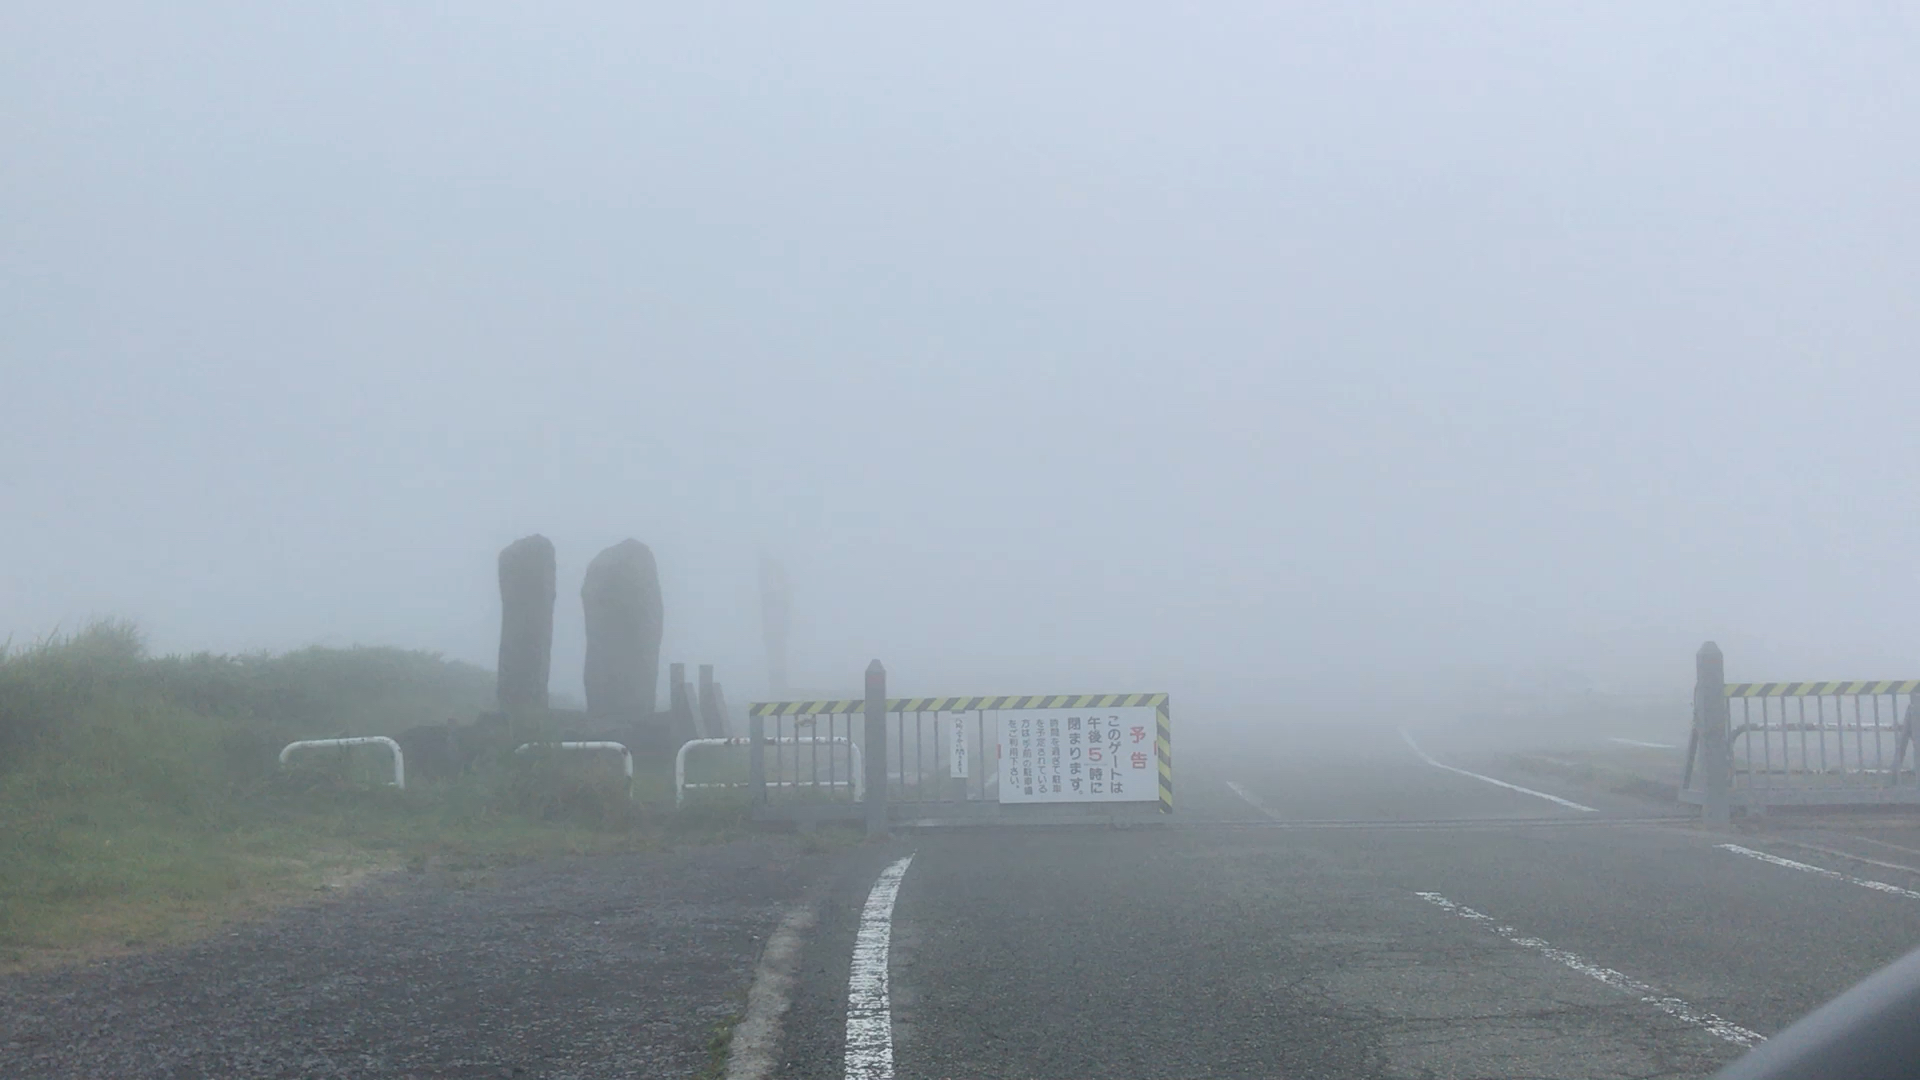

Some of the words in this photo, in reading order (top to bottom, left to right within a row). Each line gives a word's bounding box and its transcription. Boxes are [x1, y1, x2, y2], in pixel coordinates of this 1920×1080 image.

[1108, 715, 1123, 794] このゲートは
[1130, 726, 1148, 769] 予告
